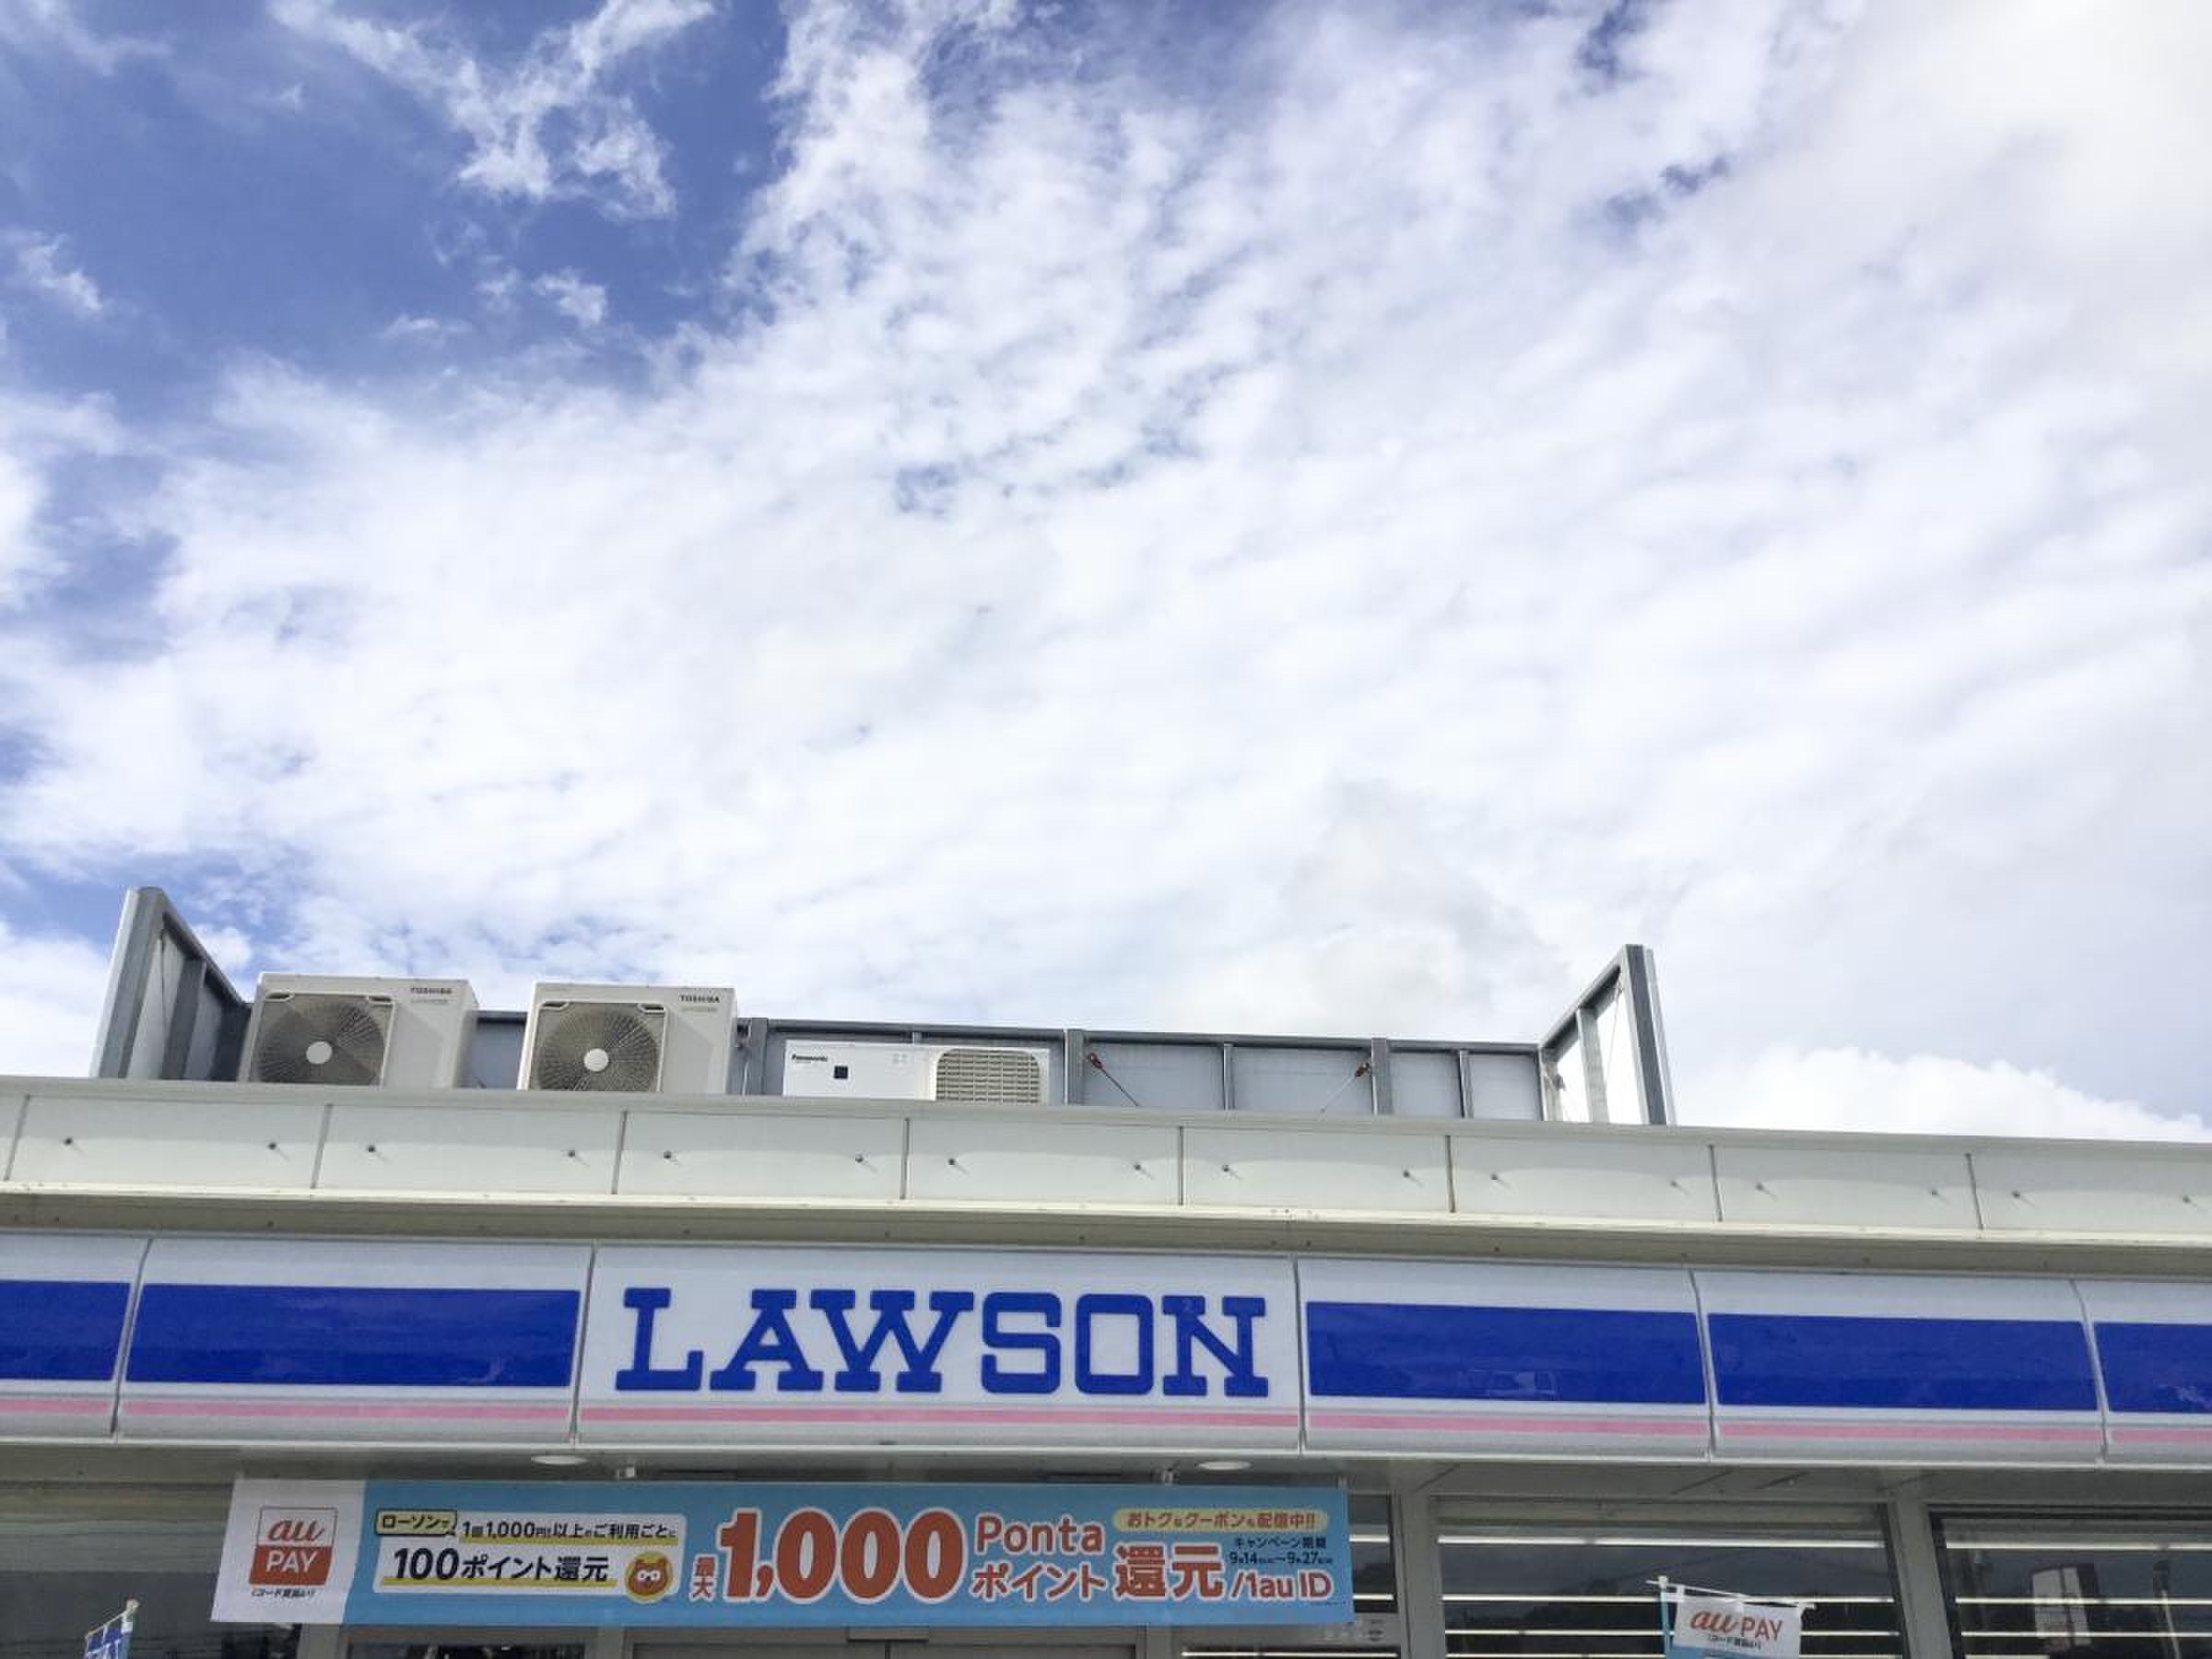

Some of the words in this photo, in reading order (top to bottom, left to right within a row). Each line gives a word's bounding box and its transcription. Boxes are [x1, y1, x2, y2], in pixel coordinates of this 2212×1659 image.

[680, 994, 721, 1004] TOSHIBA
[615, 1287, 1269, 1397] LAWSON
[266, 1519, 325, 1542] au
[975, 1514, 1104, 1554] Ponta
[265, 1549, 319, 1574] PAY
[394, 1547, 610, 1583] 100ポイント還元
[718, 1512, 967, 1605] 1,000
[971, 1561, 1109, 1600] ポイント
[1114, 1545, 1224, 1599] 還元
[1299, 1571, 1334, 1598] ID
[691, 1560, 715, 1603] 最大
[1689, 1610, 1741, 1634] au
[1740, 1616, 1783, 1641] PAY
